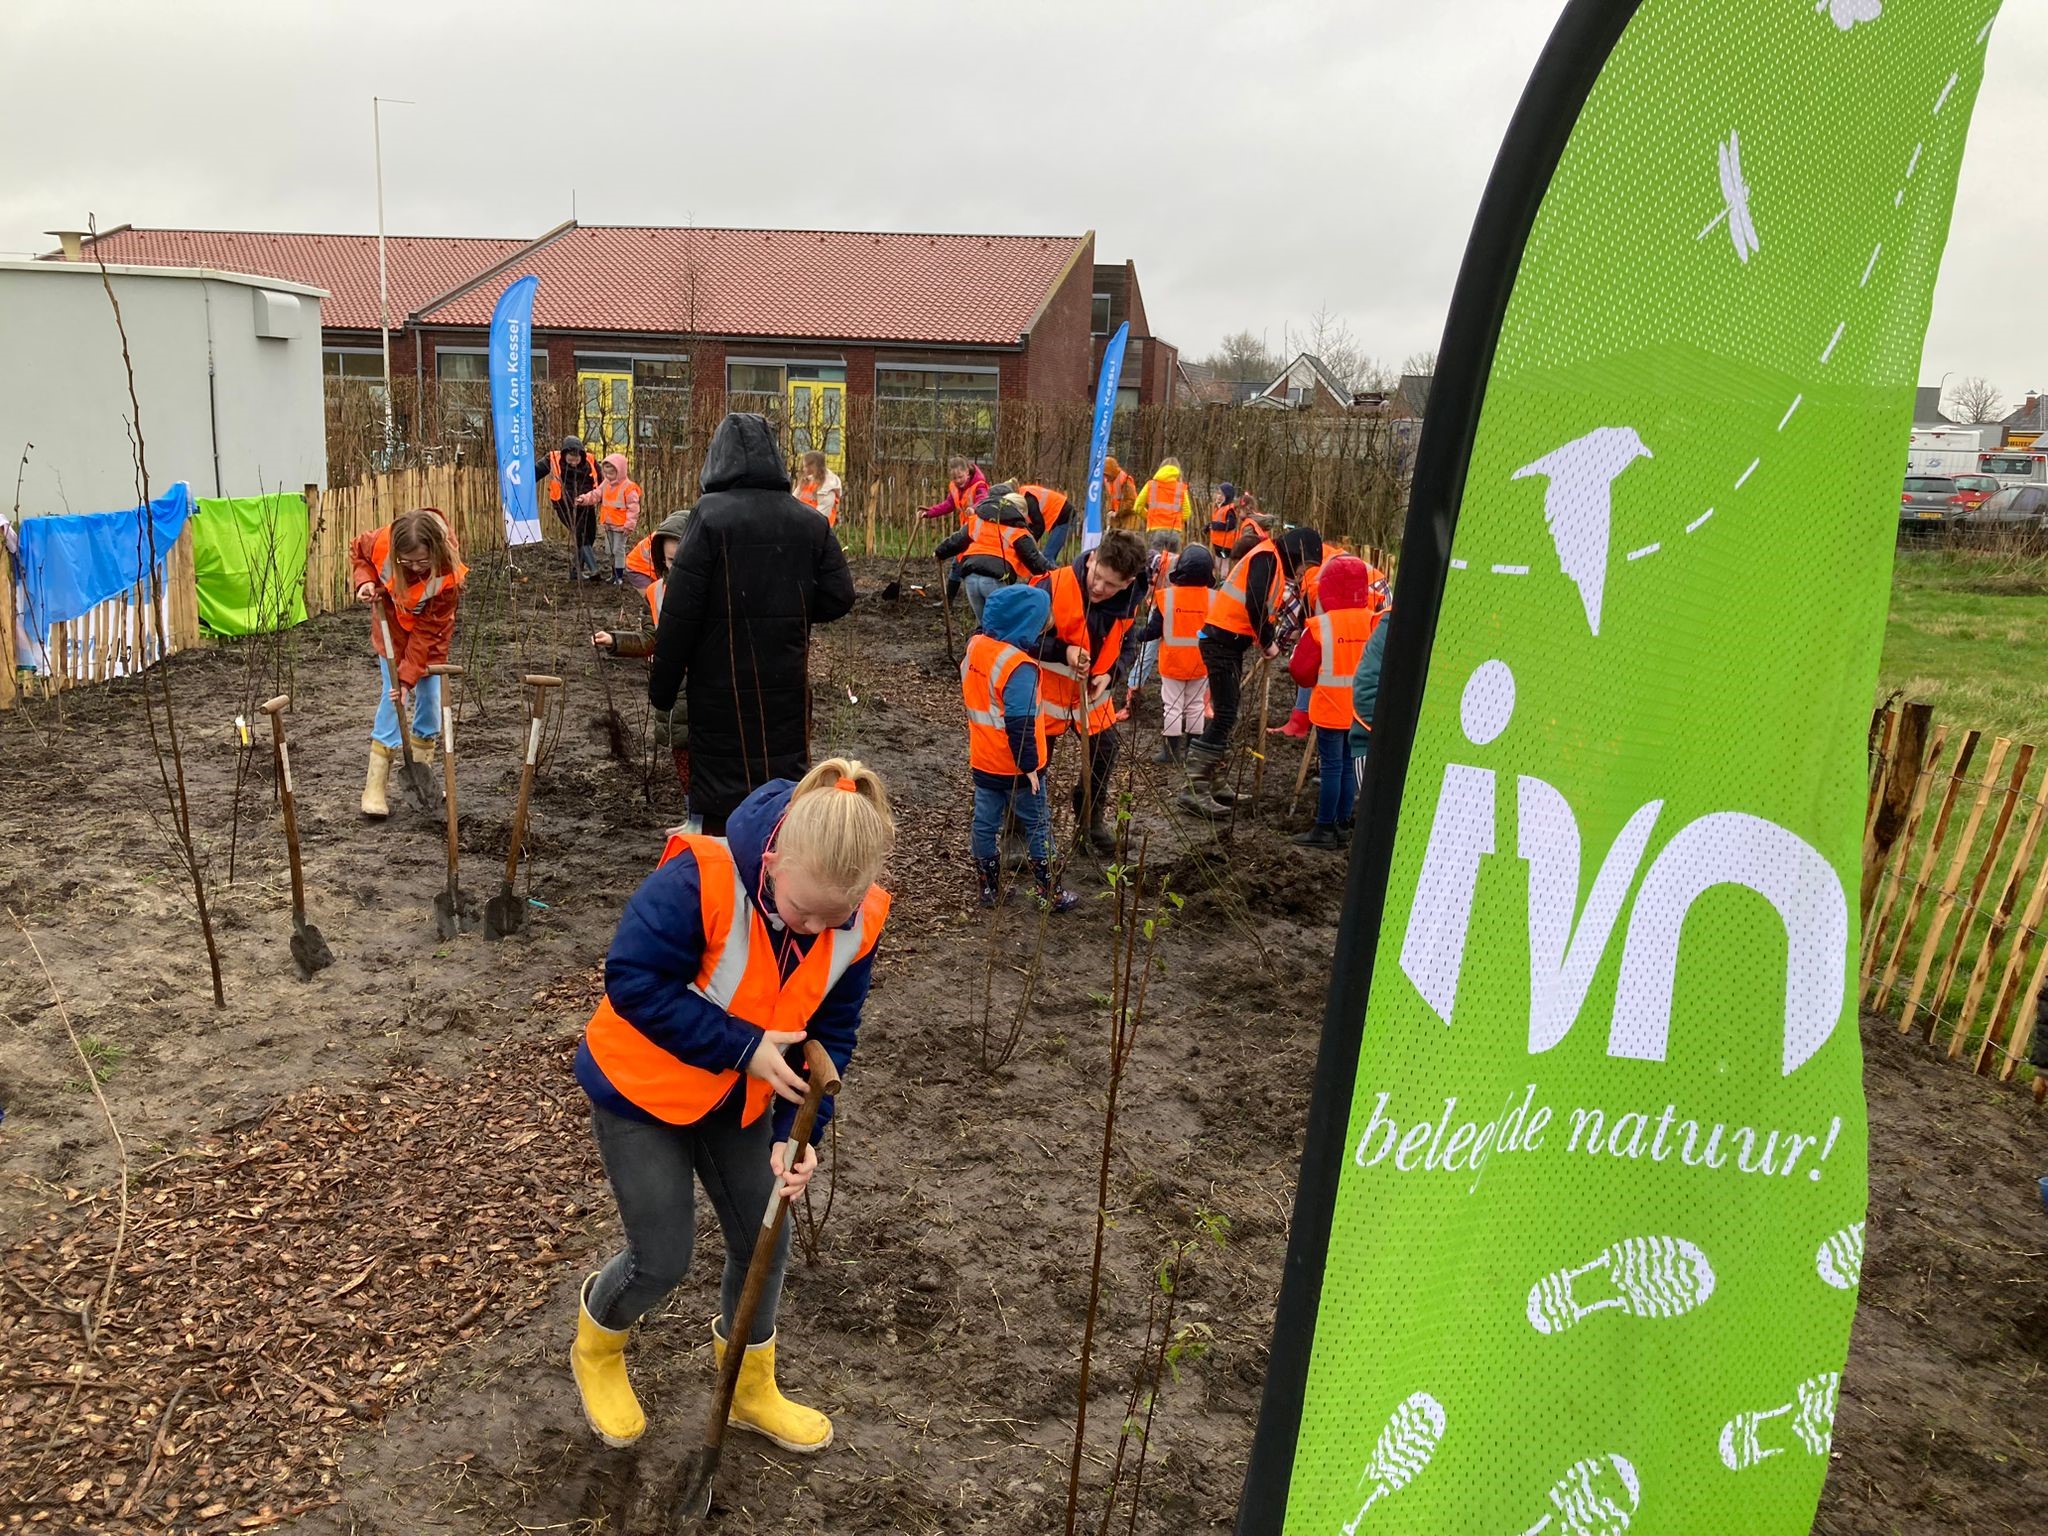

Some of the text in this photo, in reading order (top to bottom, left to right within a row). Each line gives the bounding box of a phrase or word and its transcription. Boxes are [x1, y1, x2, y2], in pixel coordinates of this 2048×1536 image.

[507, 319, 520, 456] Gebr. Van Kessel
[520, 383, 526, 393] en
[1100, 410, 1108, 436] Van
[520, 441, 528, 456] Van
[1497, 1084, 1552, 1153] de
[1567, 1104, 1841, 1181] natuur!
